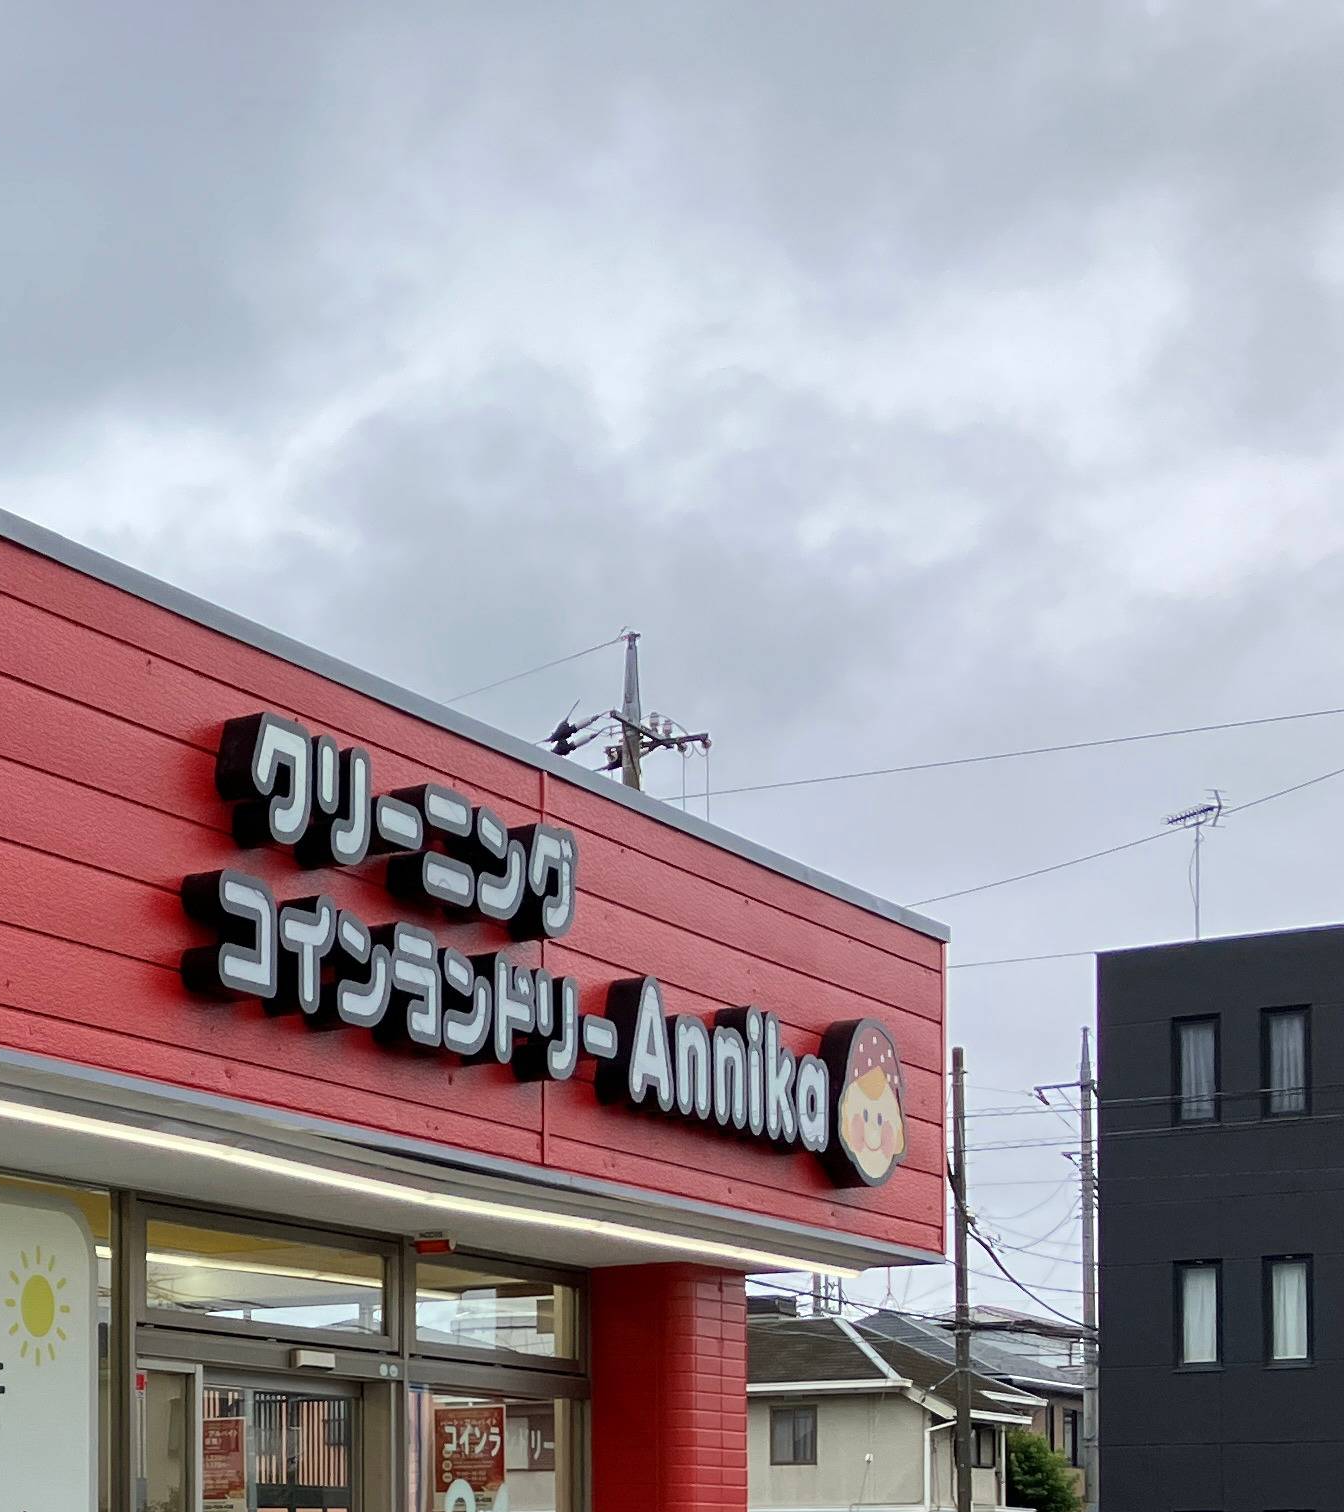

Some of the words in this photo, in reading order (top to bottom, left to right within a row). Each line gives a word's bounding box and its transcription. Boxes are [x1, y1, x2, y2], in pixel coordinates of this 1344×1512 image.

[252, 713, 577, 937] クリーニング
[219, 869, 618, 1080] コインランドリー
[627, 976, 831, 1152] Annika
